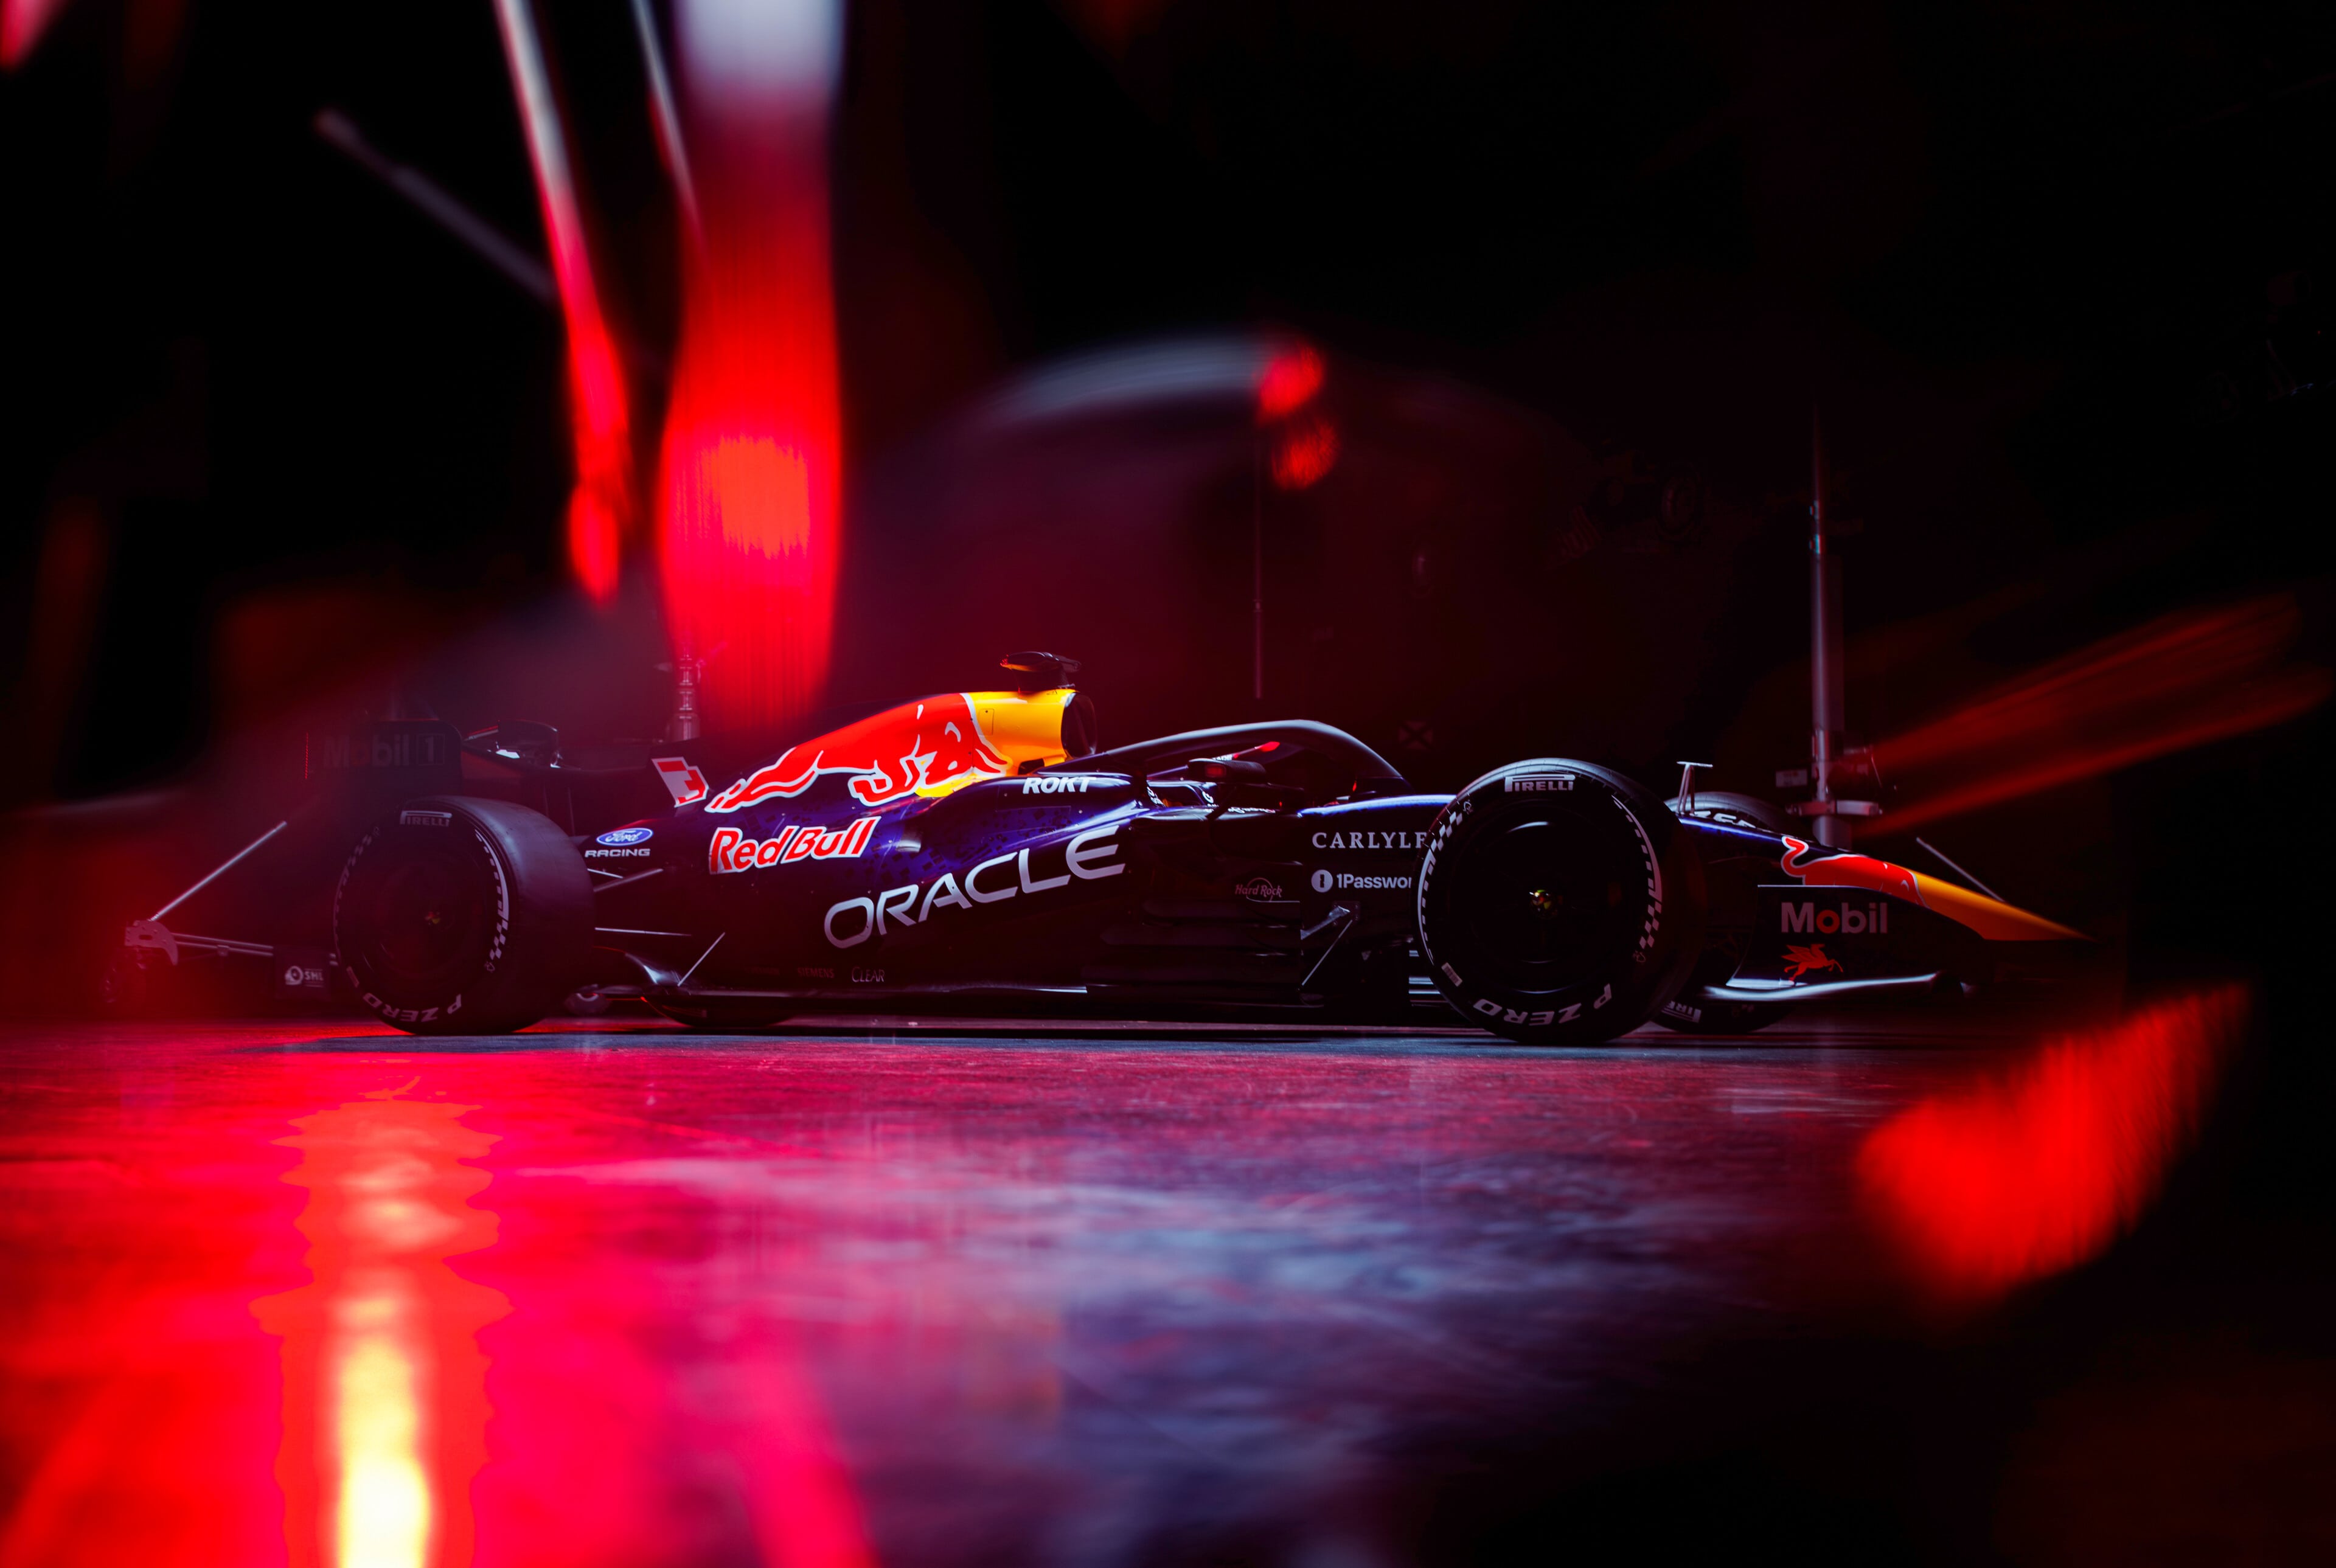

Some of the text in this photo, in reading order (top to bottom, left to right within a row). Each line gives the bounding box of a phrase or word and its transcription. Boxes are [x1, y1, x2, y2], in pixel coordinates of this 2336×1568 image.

[1022, 777, 1091, 795] ROKT
[1504, 774, 1576, 793] PIRELLI
[399, 810, 453, 827] PIRELLI
[605, 830, 643, 842] Ford
[709, 816, 881, 875] Red Bull
[585, 848, 651, 858] RACING
[824, 825, 1125, 949] ORACLE
[1234, 883, 1282, 898] Hard Rock
[1781, 902, 1888, 934] Mobil
[362, 992, 462, 1022] P ZERO
[1472, 983, 1613, 1027] P ZERO
